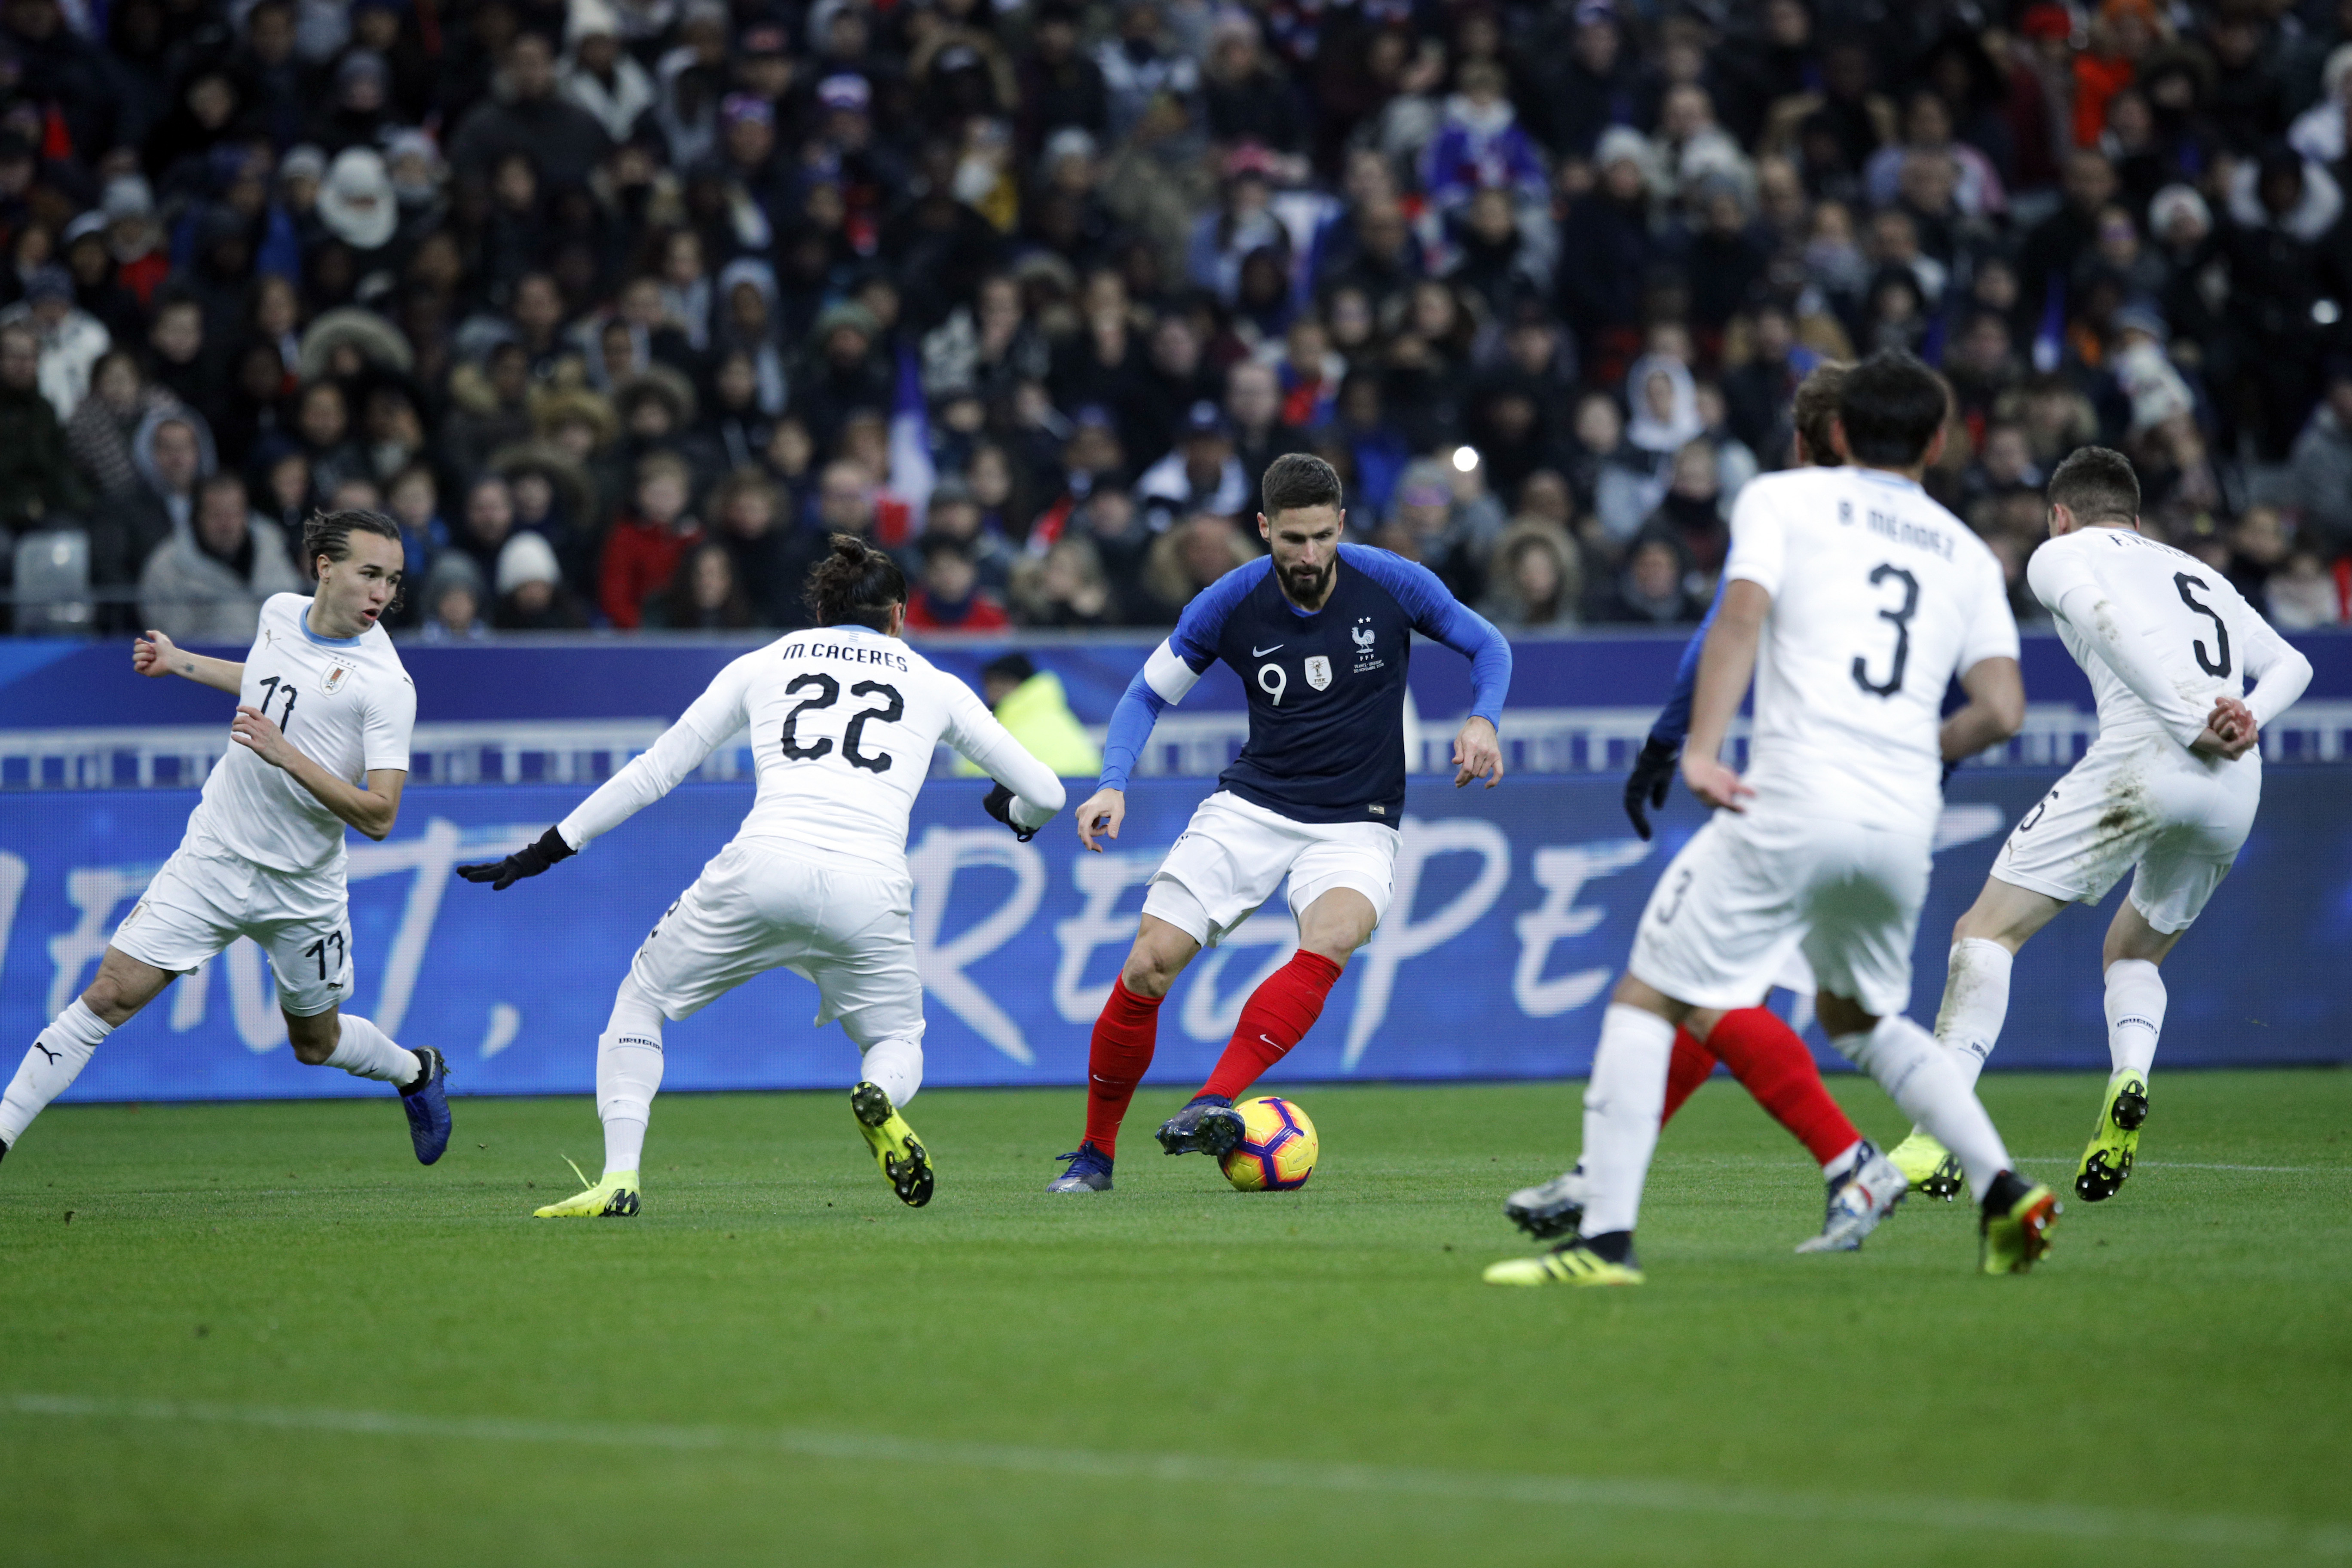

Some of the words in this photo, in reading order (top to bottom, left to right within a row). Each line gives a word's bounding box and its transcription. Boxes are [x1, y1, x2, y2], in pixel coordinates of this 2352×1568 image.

[1852, 563, 1920, 697] 3
[2173, 571, 2232, 680] 5
[781, 673, 904, 775] 22
[1257, 663, 1287, 706] 9
[1655, 868, 1693, 927] 3
